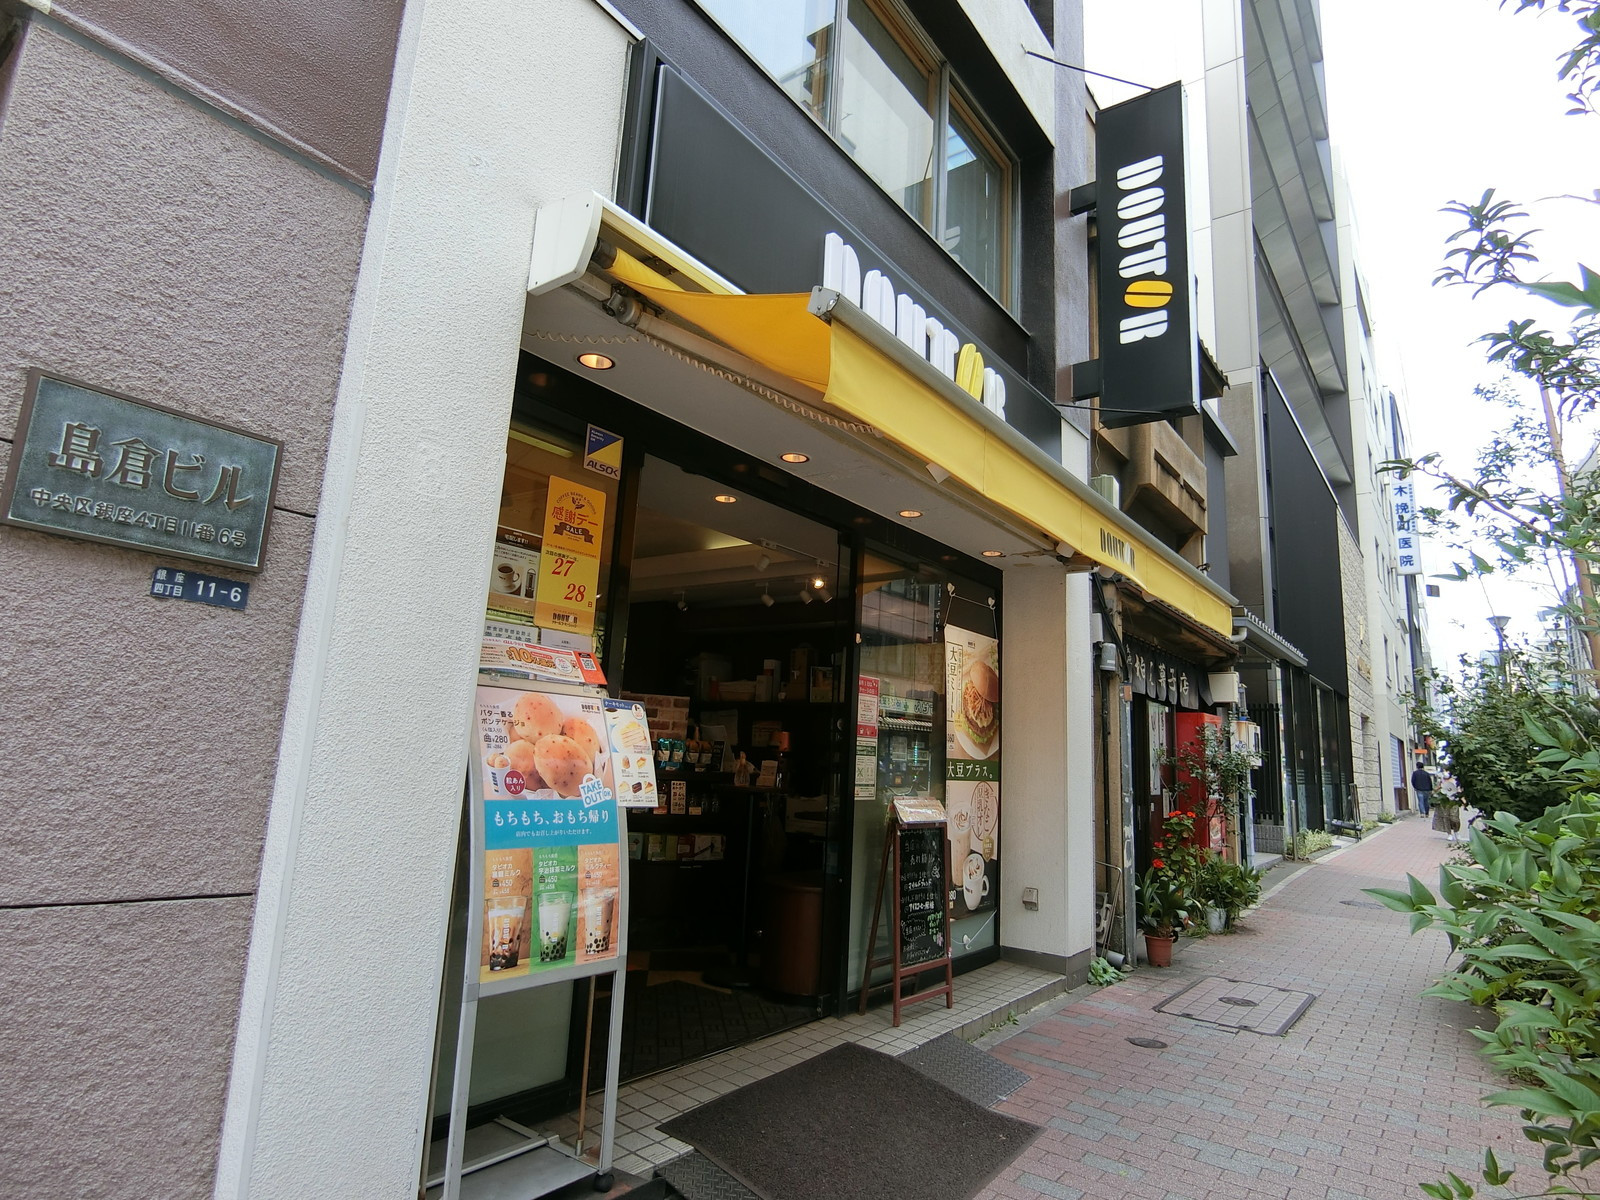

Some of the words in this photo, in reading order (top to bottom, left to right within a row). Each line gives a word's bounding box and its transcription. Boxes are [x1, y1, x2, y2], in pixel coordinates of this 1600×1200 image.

[1116, 154, 1174, 345] DOUTOR
[48, 421, 254, 513] 島倉ビル
[586, 459, 620, 478] ALSOK
[30, 487, 248, 548] 中央区銀座4丁目11番6号
[551, 505, 599, 526] 感謝デー
[565, 524, 584, 535] SALE
[1393, 485, 1414, 568] 木挽町医院
[155, 568, 186, 584] 銀座
[551, 557, 575, 577] 27
[153, 582, 183, 598] 四丁目
[196, 579, 242, 603] 11-6
[563, 583, 587, 603] 28
[949, 646, 957, 718] 大豆ミート
[947, 761, 993, 779] 大豆プラス。
[580, 779, 603, 795] TAKE
[584, 791, 603, 807] OUT
[603, 789, 612, 797] OK
[494, 809, 610, 827] もちもち、おもち帰り
